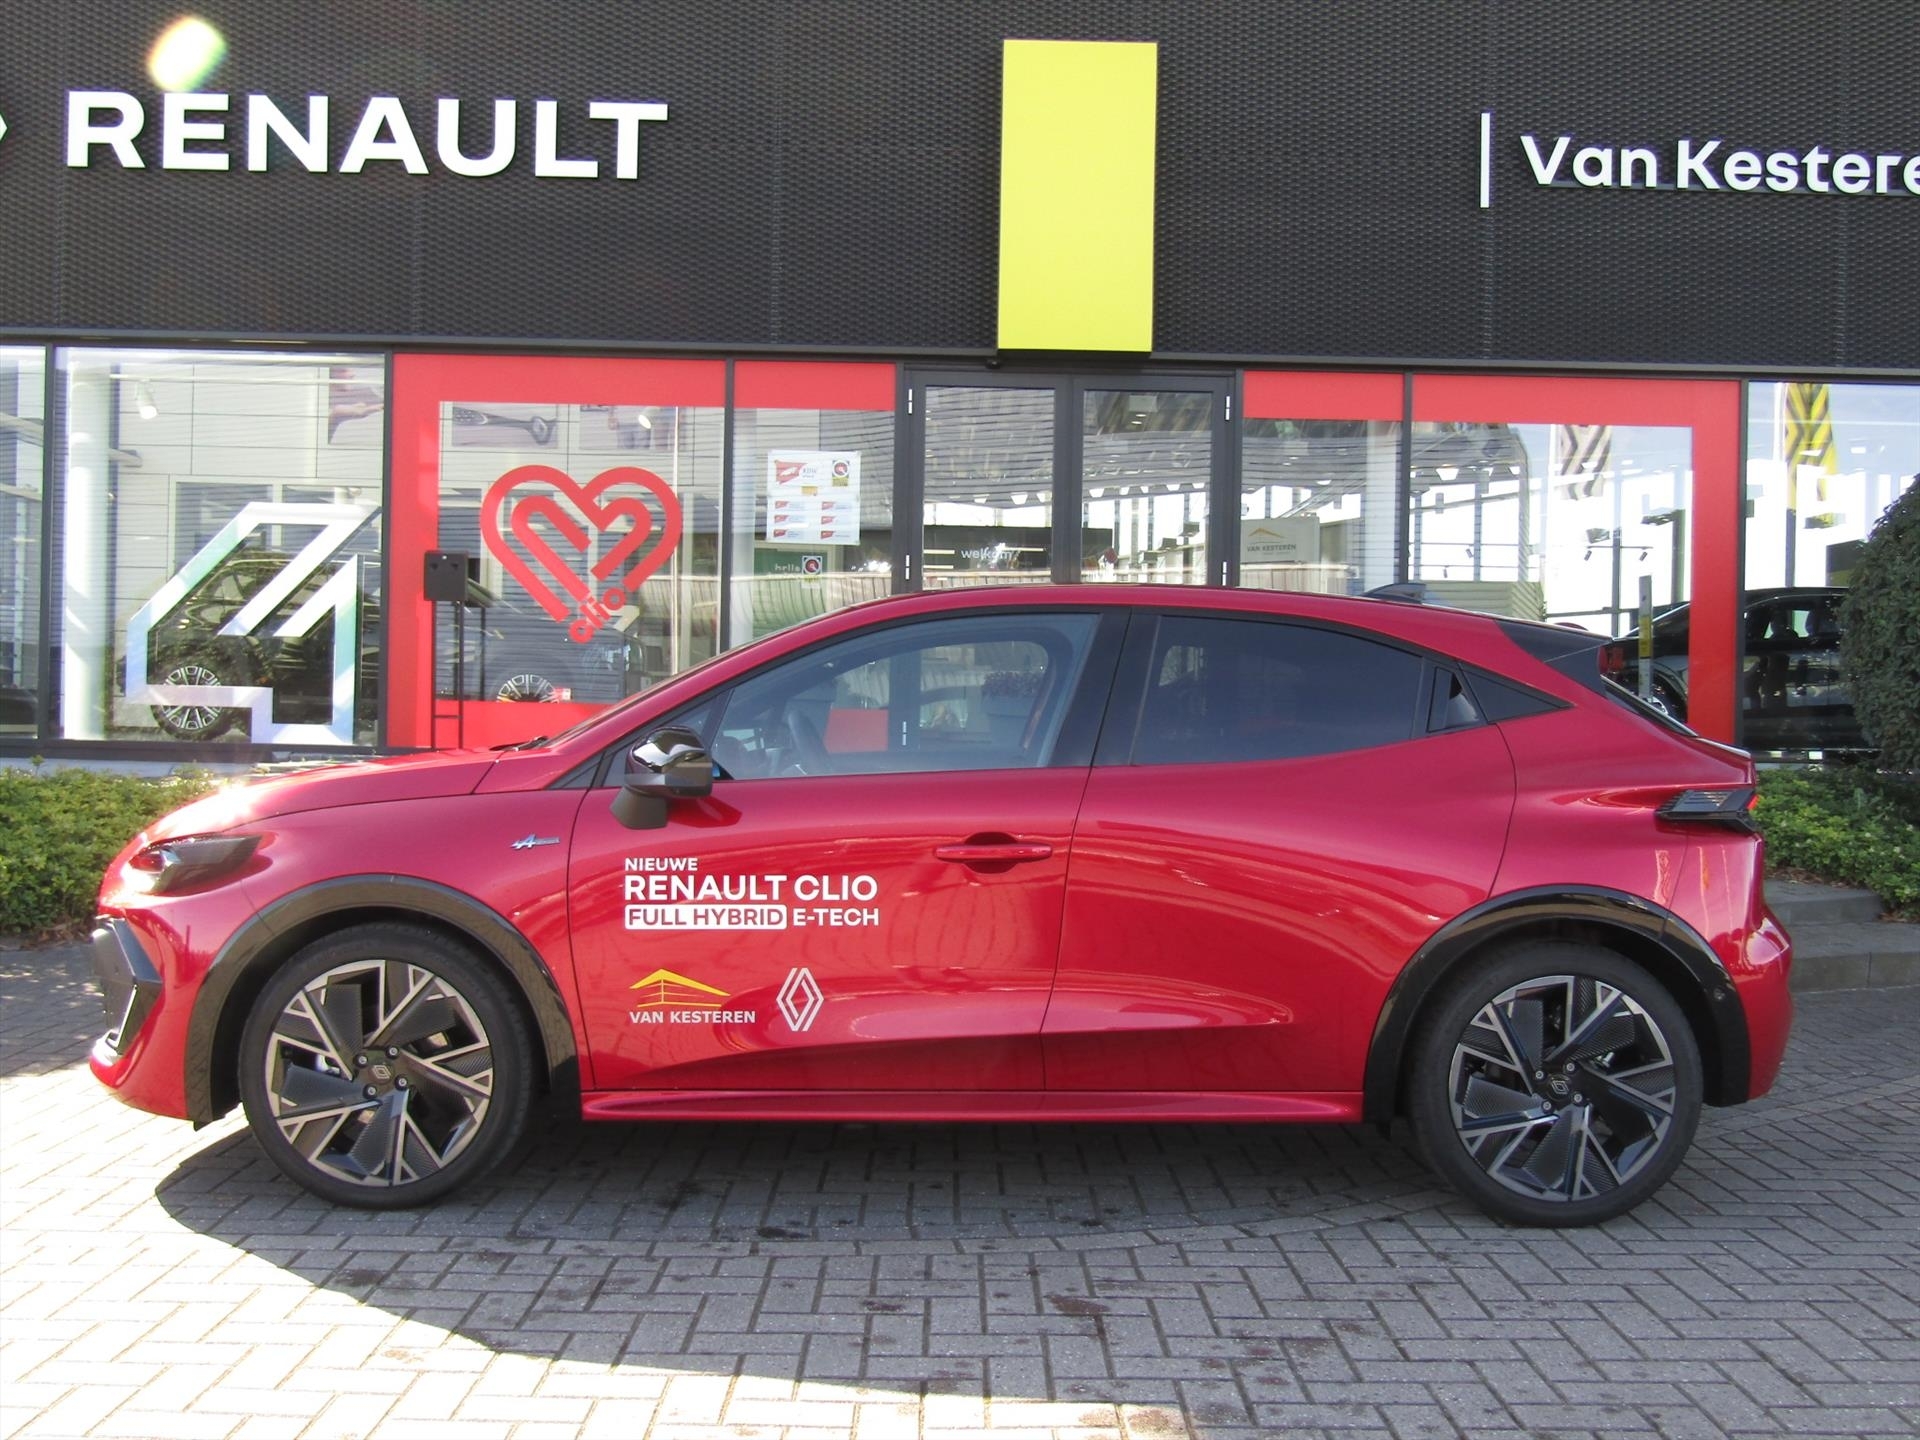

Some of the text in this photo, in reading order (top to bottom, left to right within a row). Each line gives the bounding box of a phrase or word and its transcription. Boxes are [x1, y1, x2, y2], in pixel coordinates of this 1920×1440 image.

[66, 91, 668, 179] RENAULT
[1520, 135, 1658, 188] Van
[624, 857, 698, 871] NIEUWE
[624, 874, 878, 901] RENAULT CLIO
[628, 908, 879, 926] FULL HYBRID E-TECH
[629, 1010, 756, 1024] VAN KESTEREN
